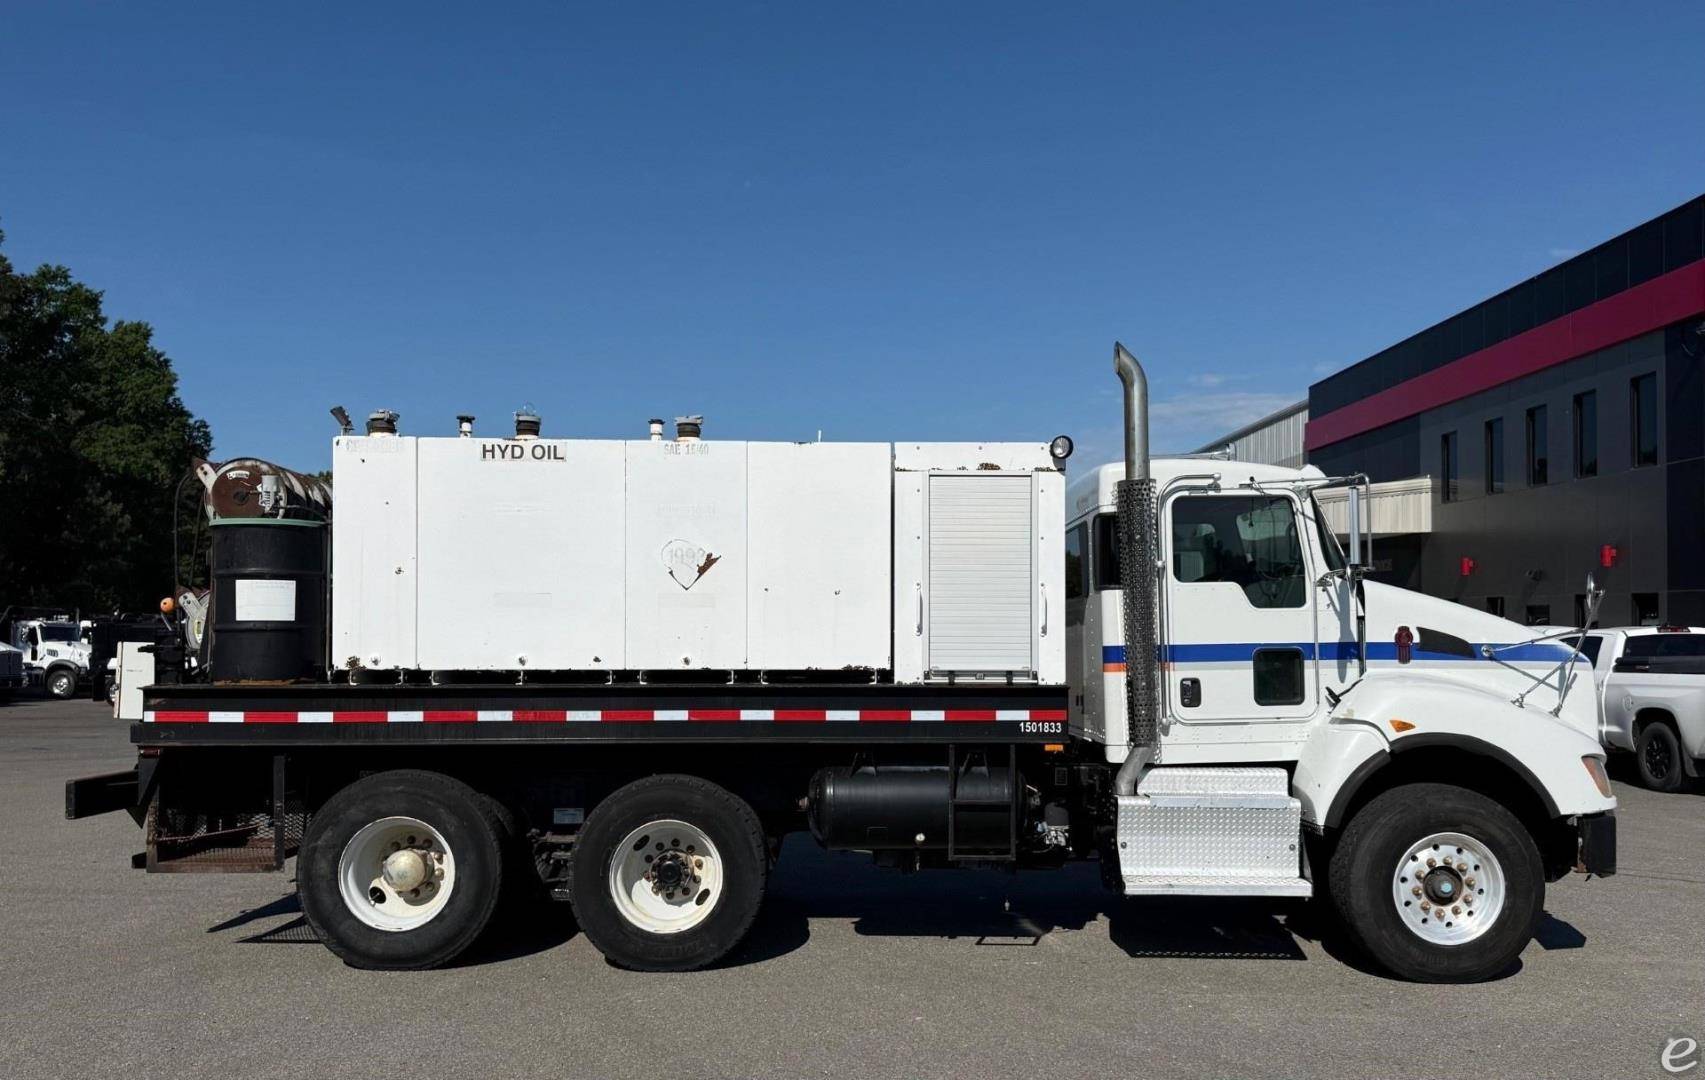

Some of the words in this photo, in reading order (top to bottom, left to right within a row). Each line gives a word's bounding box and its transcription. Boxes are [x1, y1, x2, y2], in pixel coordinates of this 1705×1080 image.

[482, 444, 525, 459] HYD
[531, 444, 565, 460] OIL
[664, 443, 681, 456] SAE
[1019, 721, 1062, 733] 1501833
